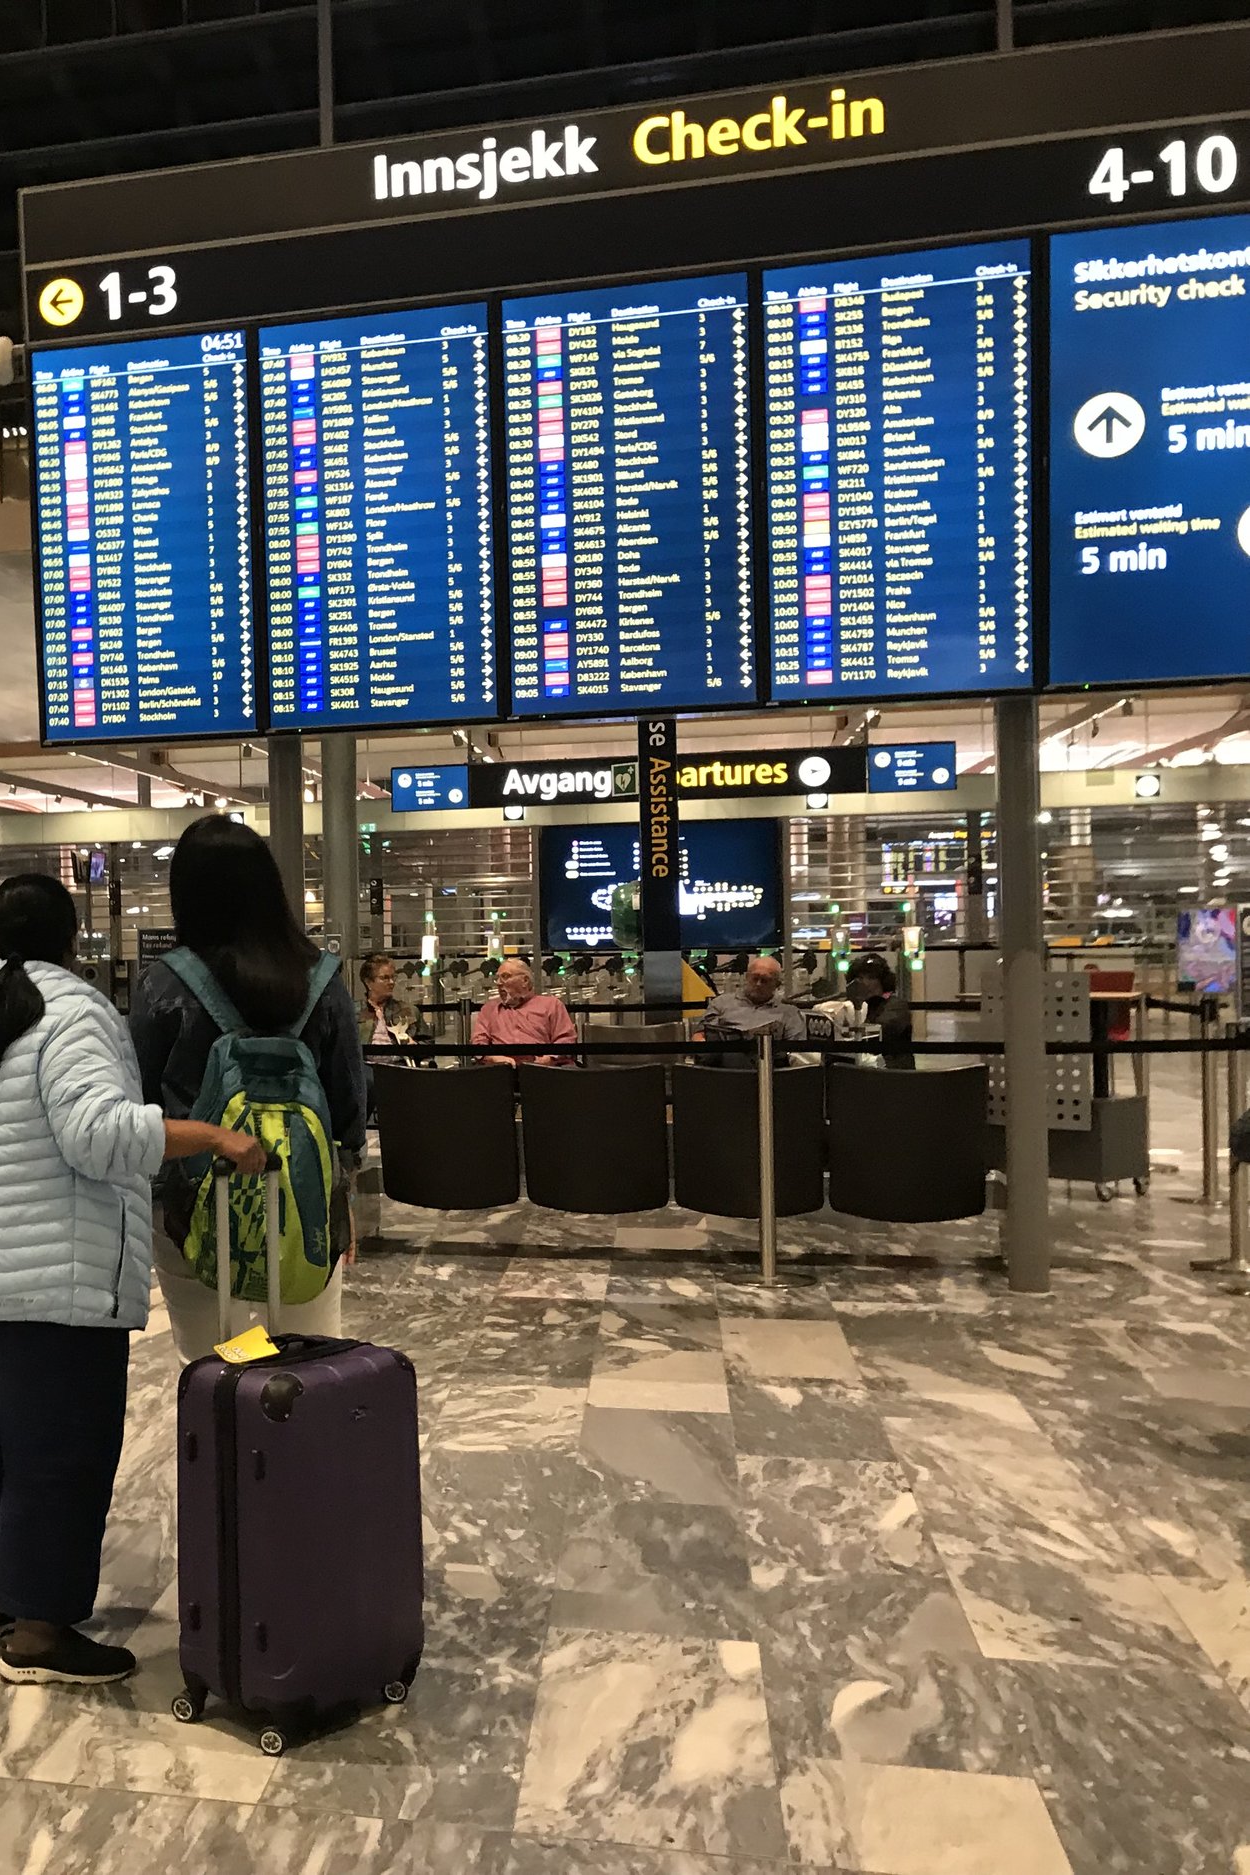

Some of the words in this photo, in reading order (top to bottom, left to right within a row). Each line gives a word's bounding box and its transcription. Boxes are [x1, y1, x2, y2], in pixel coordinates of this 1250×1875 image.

[373, 124, 599, 200] Innsjekk
[632, 88, 886, 165] Check-in
[1088, 134, 1238, 203] 4-10
[98, 265, 178, 321] 1-3
[1074, 283, 1172, 312] Security
[1177, 273, 1246, 301] check
[200, 332, 244, 352] 04:51
[1168, 424, 1188, 454] 5
[1196, 418, 1250, 451] min
[1081, 546, 1101, 575] 5
[1109, 541, 1167, 573] min
[513, 598, 536, 607] 08:55
[618, 589, 662, 599] Trondheim
[271, 616, 292, 625] 08:00
[369, 610, 395, 618] Bergen
[449, 603, 463, 612] 5/6
[513, 611, 536, 620] 08:55
[619, 604, 647, 614] Bergen
[514, 624, 537, 633] 08:55
[619, 618, 654, 626] Kirkenes
[705, 611, 720, 620] 5/6
[774, 620, 799, 630] 10:00
[979, 607, 995, 617] 5/6
[271, 629, 293, 637] 08:00
[449, 616, 463, 625] 5/6
[775, 633, 799, 644] 10:05
[979, 620, 995, 631] 5/6
[46, 644, 66, 653] 07:05
[211, 634, 224, 642] 5/6
[272, 641, 293, 650] 08:10
[369, 631, 434, 643] London/Stansted
[514, 637, 537, 646] 09:00
[619, 630, 660, 640] Bardufoss
[775, 647, 799, 657] 10:15
[979, 634, 995, 645] 5/6
[47, 656, 67, 666] 07:10
[272, 654, 293, 663] 08:10
[370, 647, 396, 656] Brussel
[450, 642, 464, 651] 5/6
[514, 650, 538, 659] 09:00
[620, 643, 660, 653] Barcelona
[775, 661, 799, 671] 10:25
[979, 649, 996, 659] 5/6
[47, 669, 67, 678] 07:10
[212, 659, 225, 668] 5/6
[272, 667, 294, 675] 08:10
[370, 660, 397, 669] Aarhus
[450, 655, 464, 664] 5/6
[515, 663, 538, 672] 09:05
[620, 657, 653, 666] Aalborg
[48, 681, 68, 690] 07:15
[213, 672, 222, 680] 10
[273, 679, 294, 688] 08:10
[370, 673, 395, 681] Molde
[451, 668, 465, 677] 5/6
[515, 676, 538, 686] 09:05
[515, 689, 538, 698] 09:05
[621, 684, 662, 692] Stavanger
[707, 678, 722, 687] 5/6
[776, 674, 800, 684] 10:35
[48, 693, 68, 702] 07:20
[273, 692, 294, 700] 08:15
[371, 684, 414, 695] Haugesund
[451, 681, 465, 689] 5/6
[49, 705, 69, 714] 07:40
[274, 704, 295, 713] 08:15
[371, 699, 409, 707] Stavanger
[451, 693, 465, 702] 5/6
[502, 768, 612, 801] Avgang
[676, 761, 789, 788] artures
[649, 756, 672, 878] Assistance
